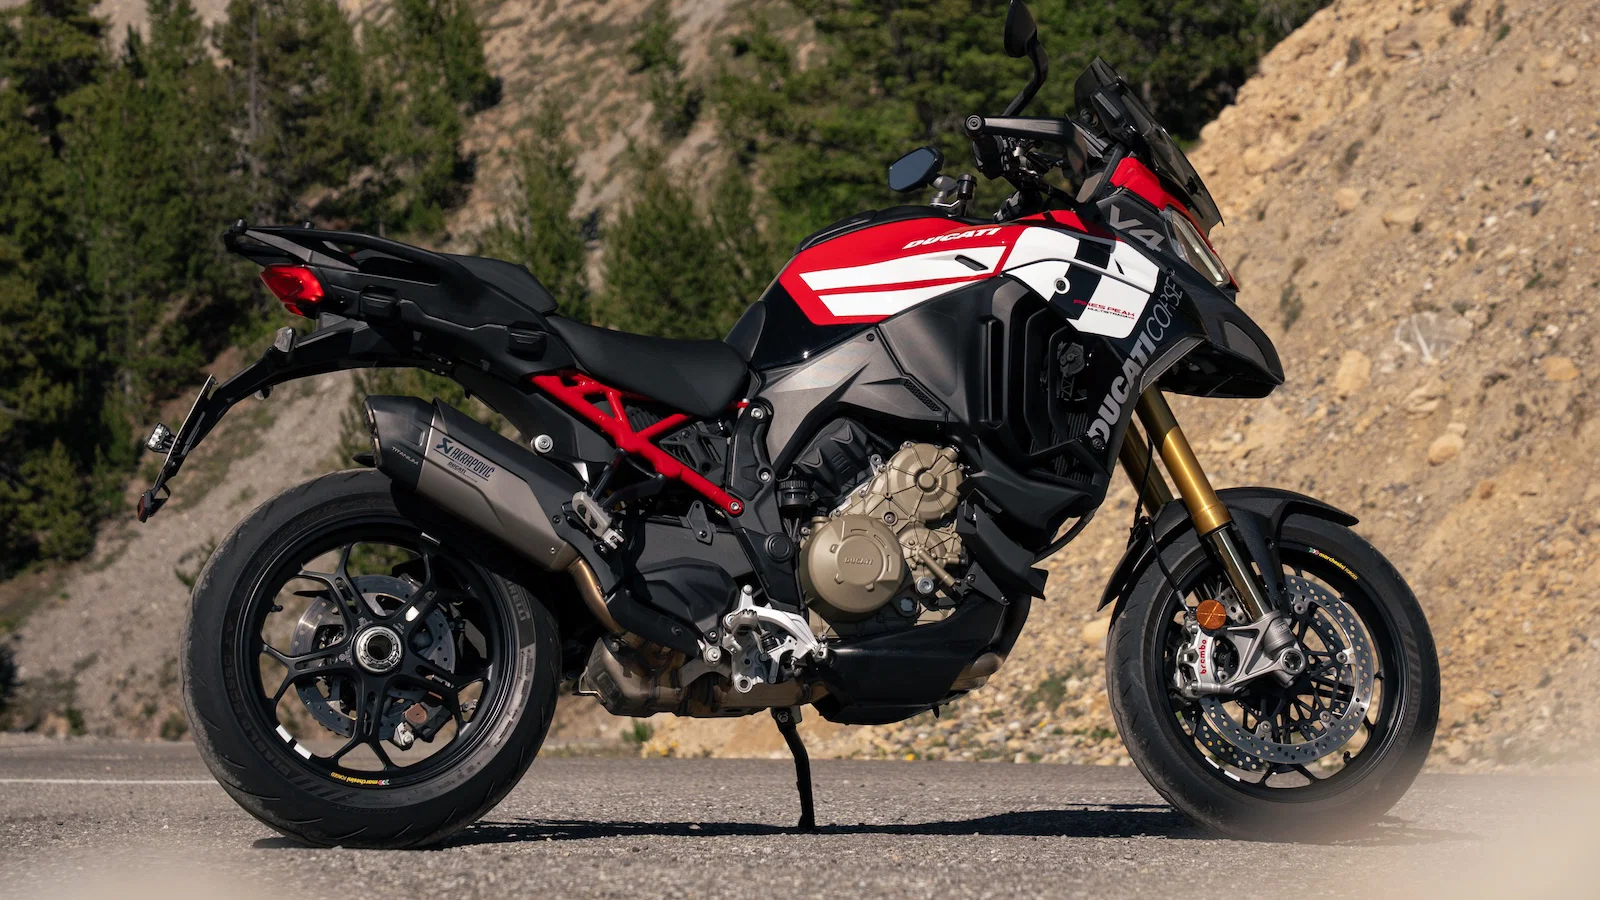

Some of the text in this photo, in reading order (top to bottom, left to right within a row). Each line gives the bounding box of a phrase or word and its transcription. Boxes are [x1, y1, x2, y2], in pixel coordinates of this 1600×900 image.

[902, 227, 1002, 250] DUCATI
[1110, 204, 1165, 252] V4
[1107, 306, 1135, 317] PEAK
[1088, 279, 1183, 444] DUCATI CORSE
[391, 446, 419, 466] TITANIUM
[844, 557, 873, 565] DUCATI
[1199, 639, 1207, 675] brembo
